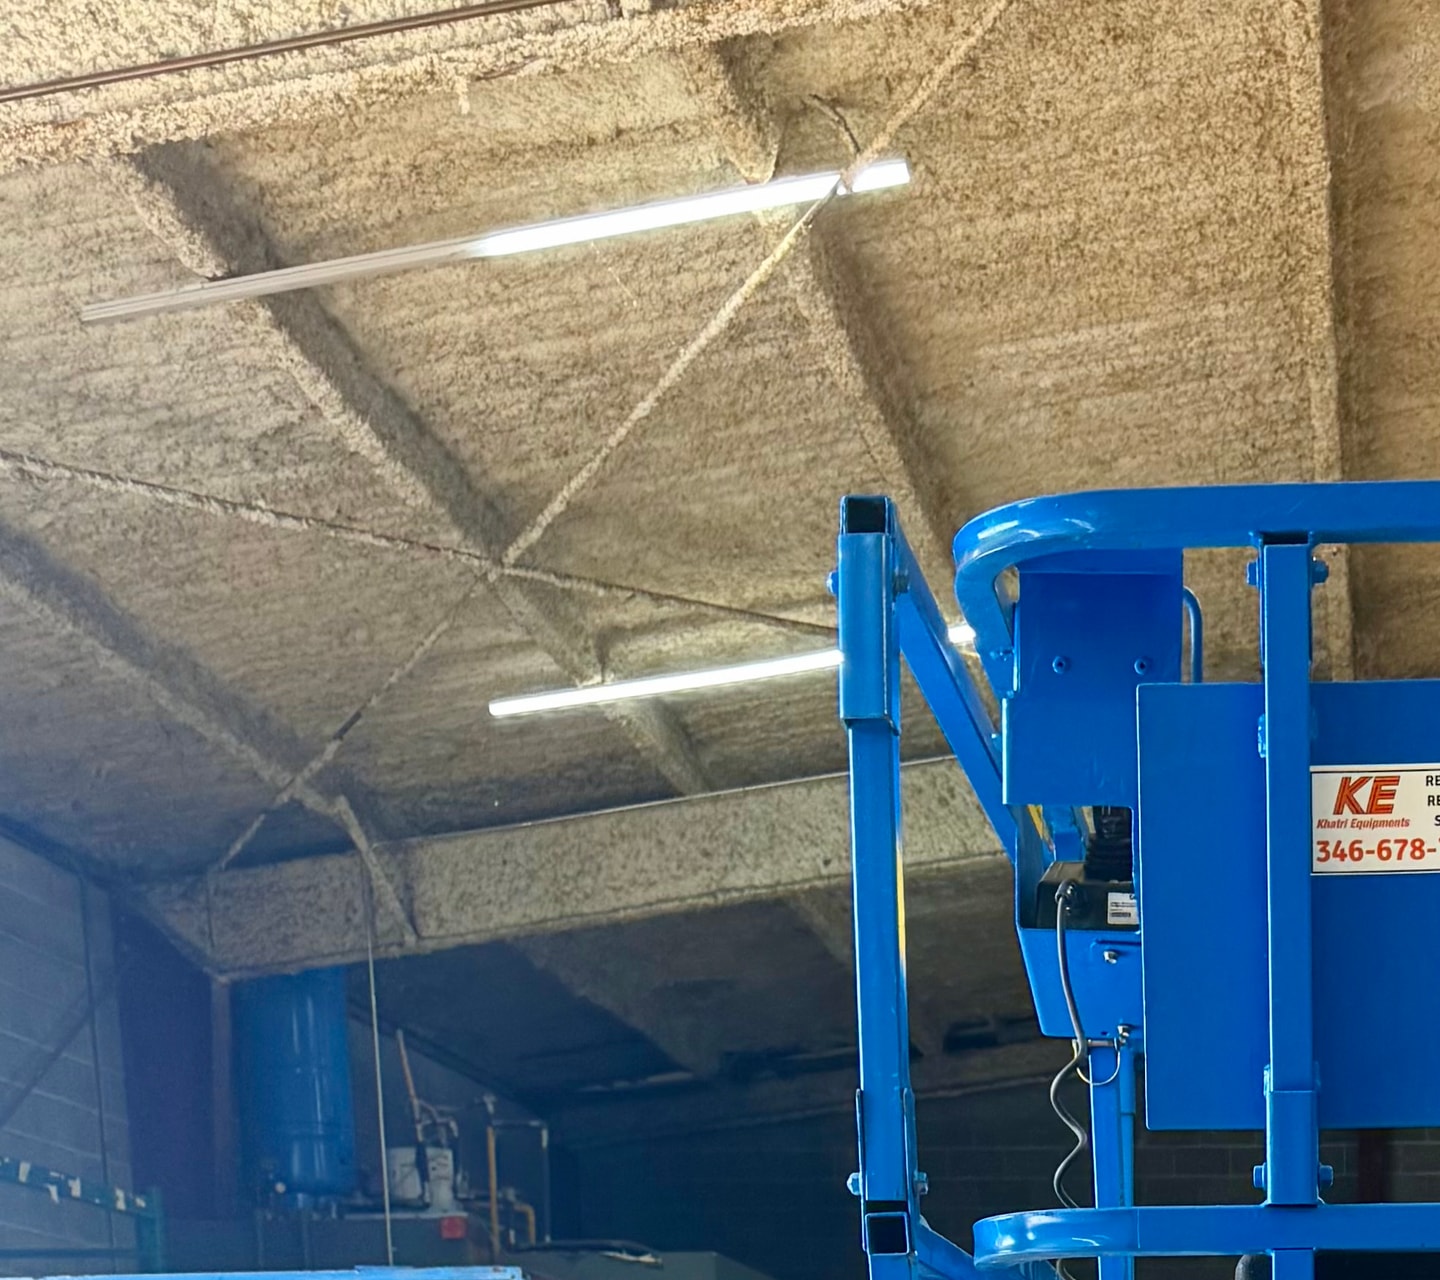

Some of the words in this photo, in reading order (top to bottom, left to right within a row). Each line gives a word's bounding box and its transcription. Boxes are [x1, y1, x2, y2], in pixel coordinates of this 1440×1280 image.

[1332, 775, 1401, 816] KE
[1316, 818, 1348, 830] Khatri
[1350, 816, 1411, 831] Equipments
